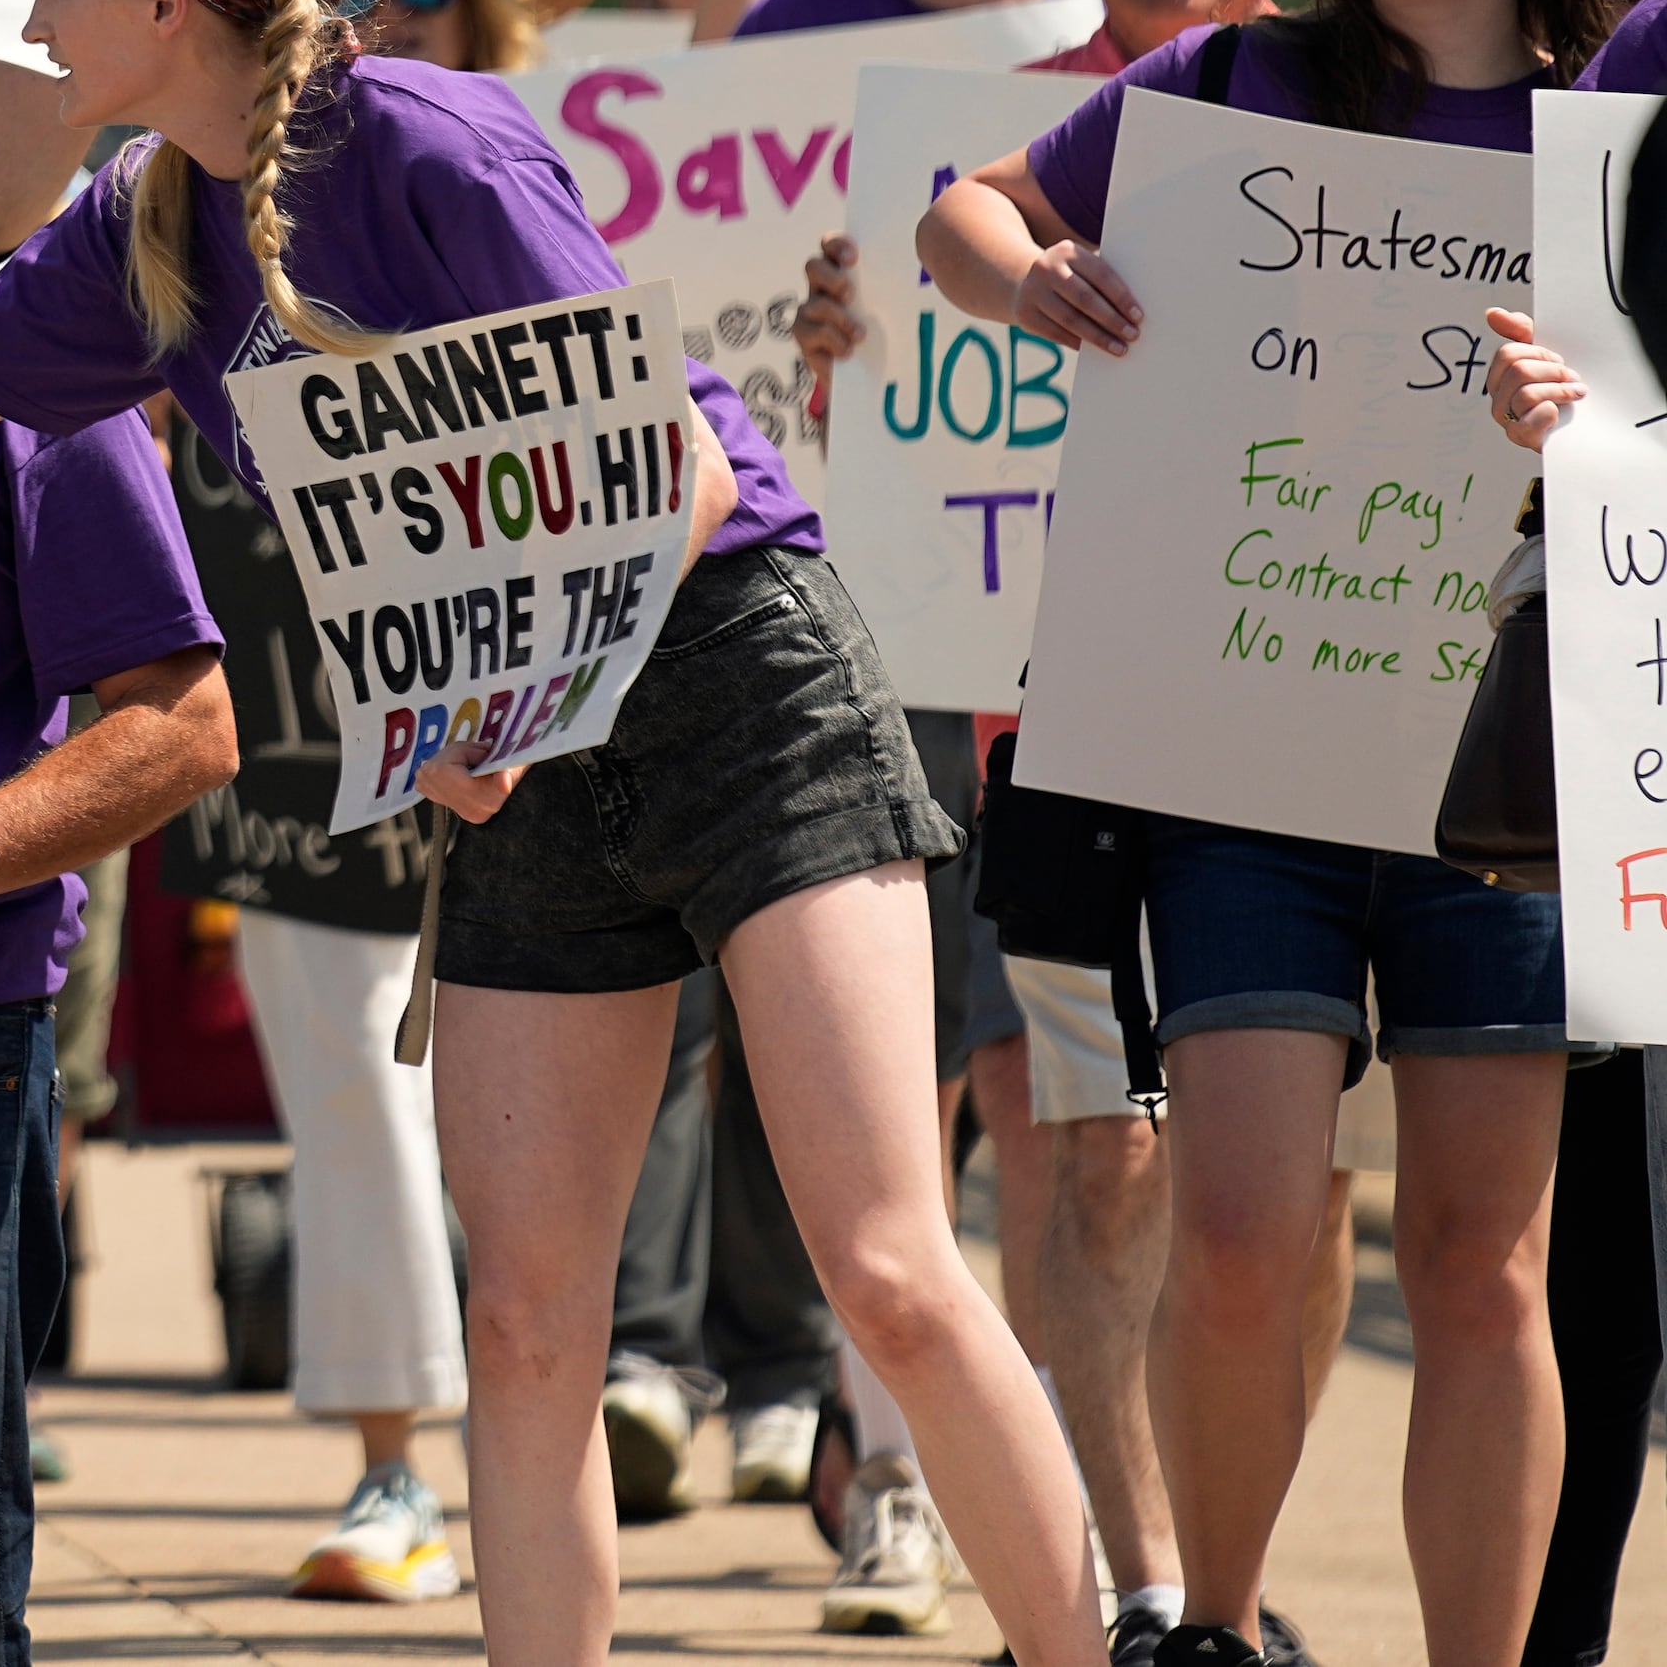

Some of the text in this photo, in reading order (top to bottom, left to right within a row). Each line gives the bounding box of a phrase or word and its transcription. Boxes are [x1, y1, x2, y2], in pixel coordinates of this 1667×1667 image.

[561, 66, 848, 245] Sav
[1251, 327, 1318, 381] on
[292, 465, 447, 575] IT'S
[596, 420, 685, 528] HI!
[1240, 437, 1332, 513] Fair
[1225, 528, 1413, 607] Contract
[319, 575, 536, 705] YOU'RE
[562, 552, 654, 659] THE
[1221, 605, 1285, 663] No
[1311, 637, 1403, 676] more
